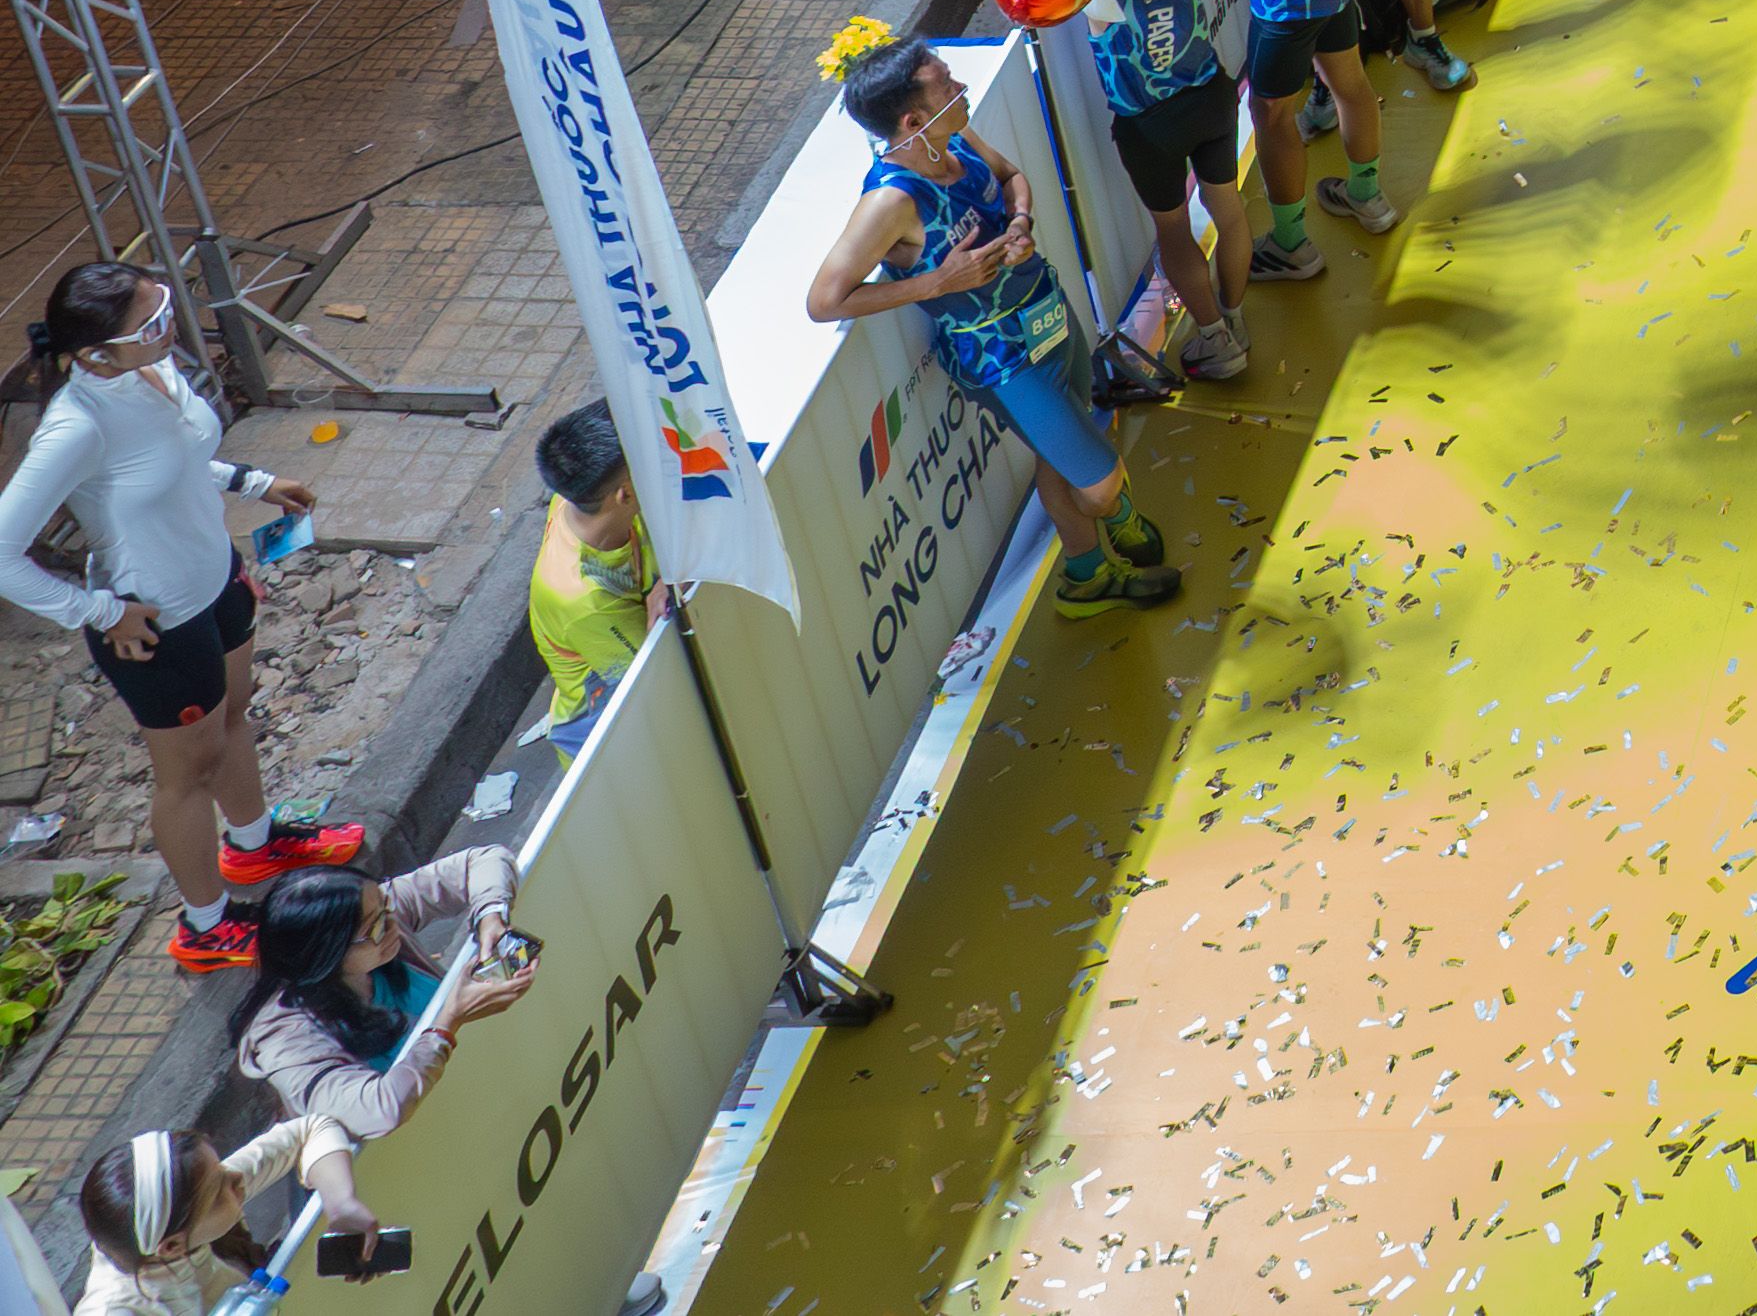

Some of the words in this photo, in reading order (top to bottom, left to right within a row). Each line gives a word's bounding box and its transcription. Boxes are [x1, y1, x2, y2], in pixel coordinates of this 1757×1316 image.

[859, 495, 910, 598] NHÀ
[906, 384, 965, 500] THUỐ
[904, 367, 922, 404] FPT
[855, 525, 938, 699] LONG
[941, 398, 1007, 531] CHÂ
